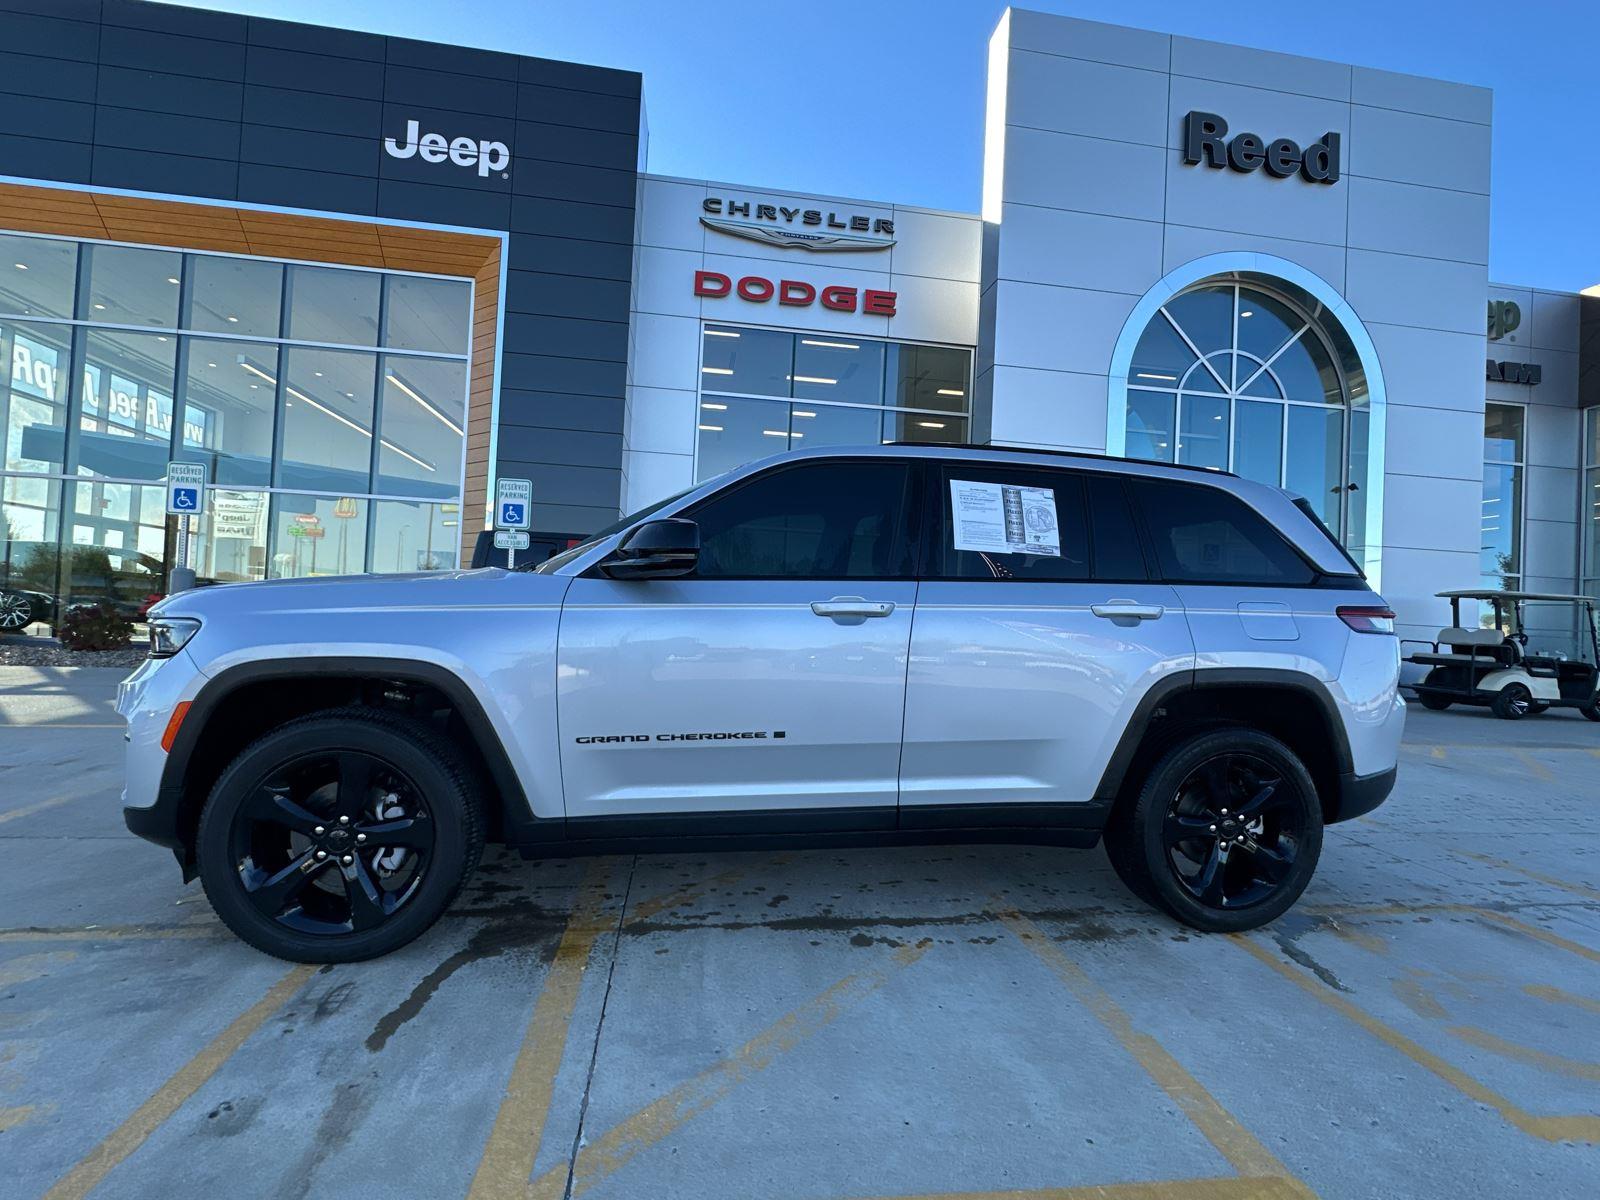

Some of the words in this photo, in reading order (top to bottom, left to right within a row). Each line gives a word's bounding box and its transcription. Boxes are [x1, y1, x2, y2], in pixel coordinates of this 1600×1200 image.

[384, 120, 510, 177] Jeep
[1184, 111, 1341, 185] Reed
[702, 198, 895, 234] CHRYSLER
[694, 271, 898, 317] DODGE
[171, 466, 202, 475] RESERVED
[170, 476, 202, 484] PARKING
[500, 483, 528, 491] RESERVED
[500, 491, 528, 500] PARKING
[575, 734, 650, 744] GRAND
[656, 731, 767, 741] CHEROKEE
